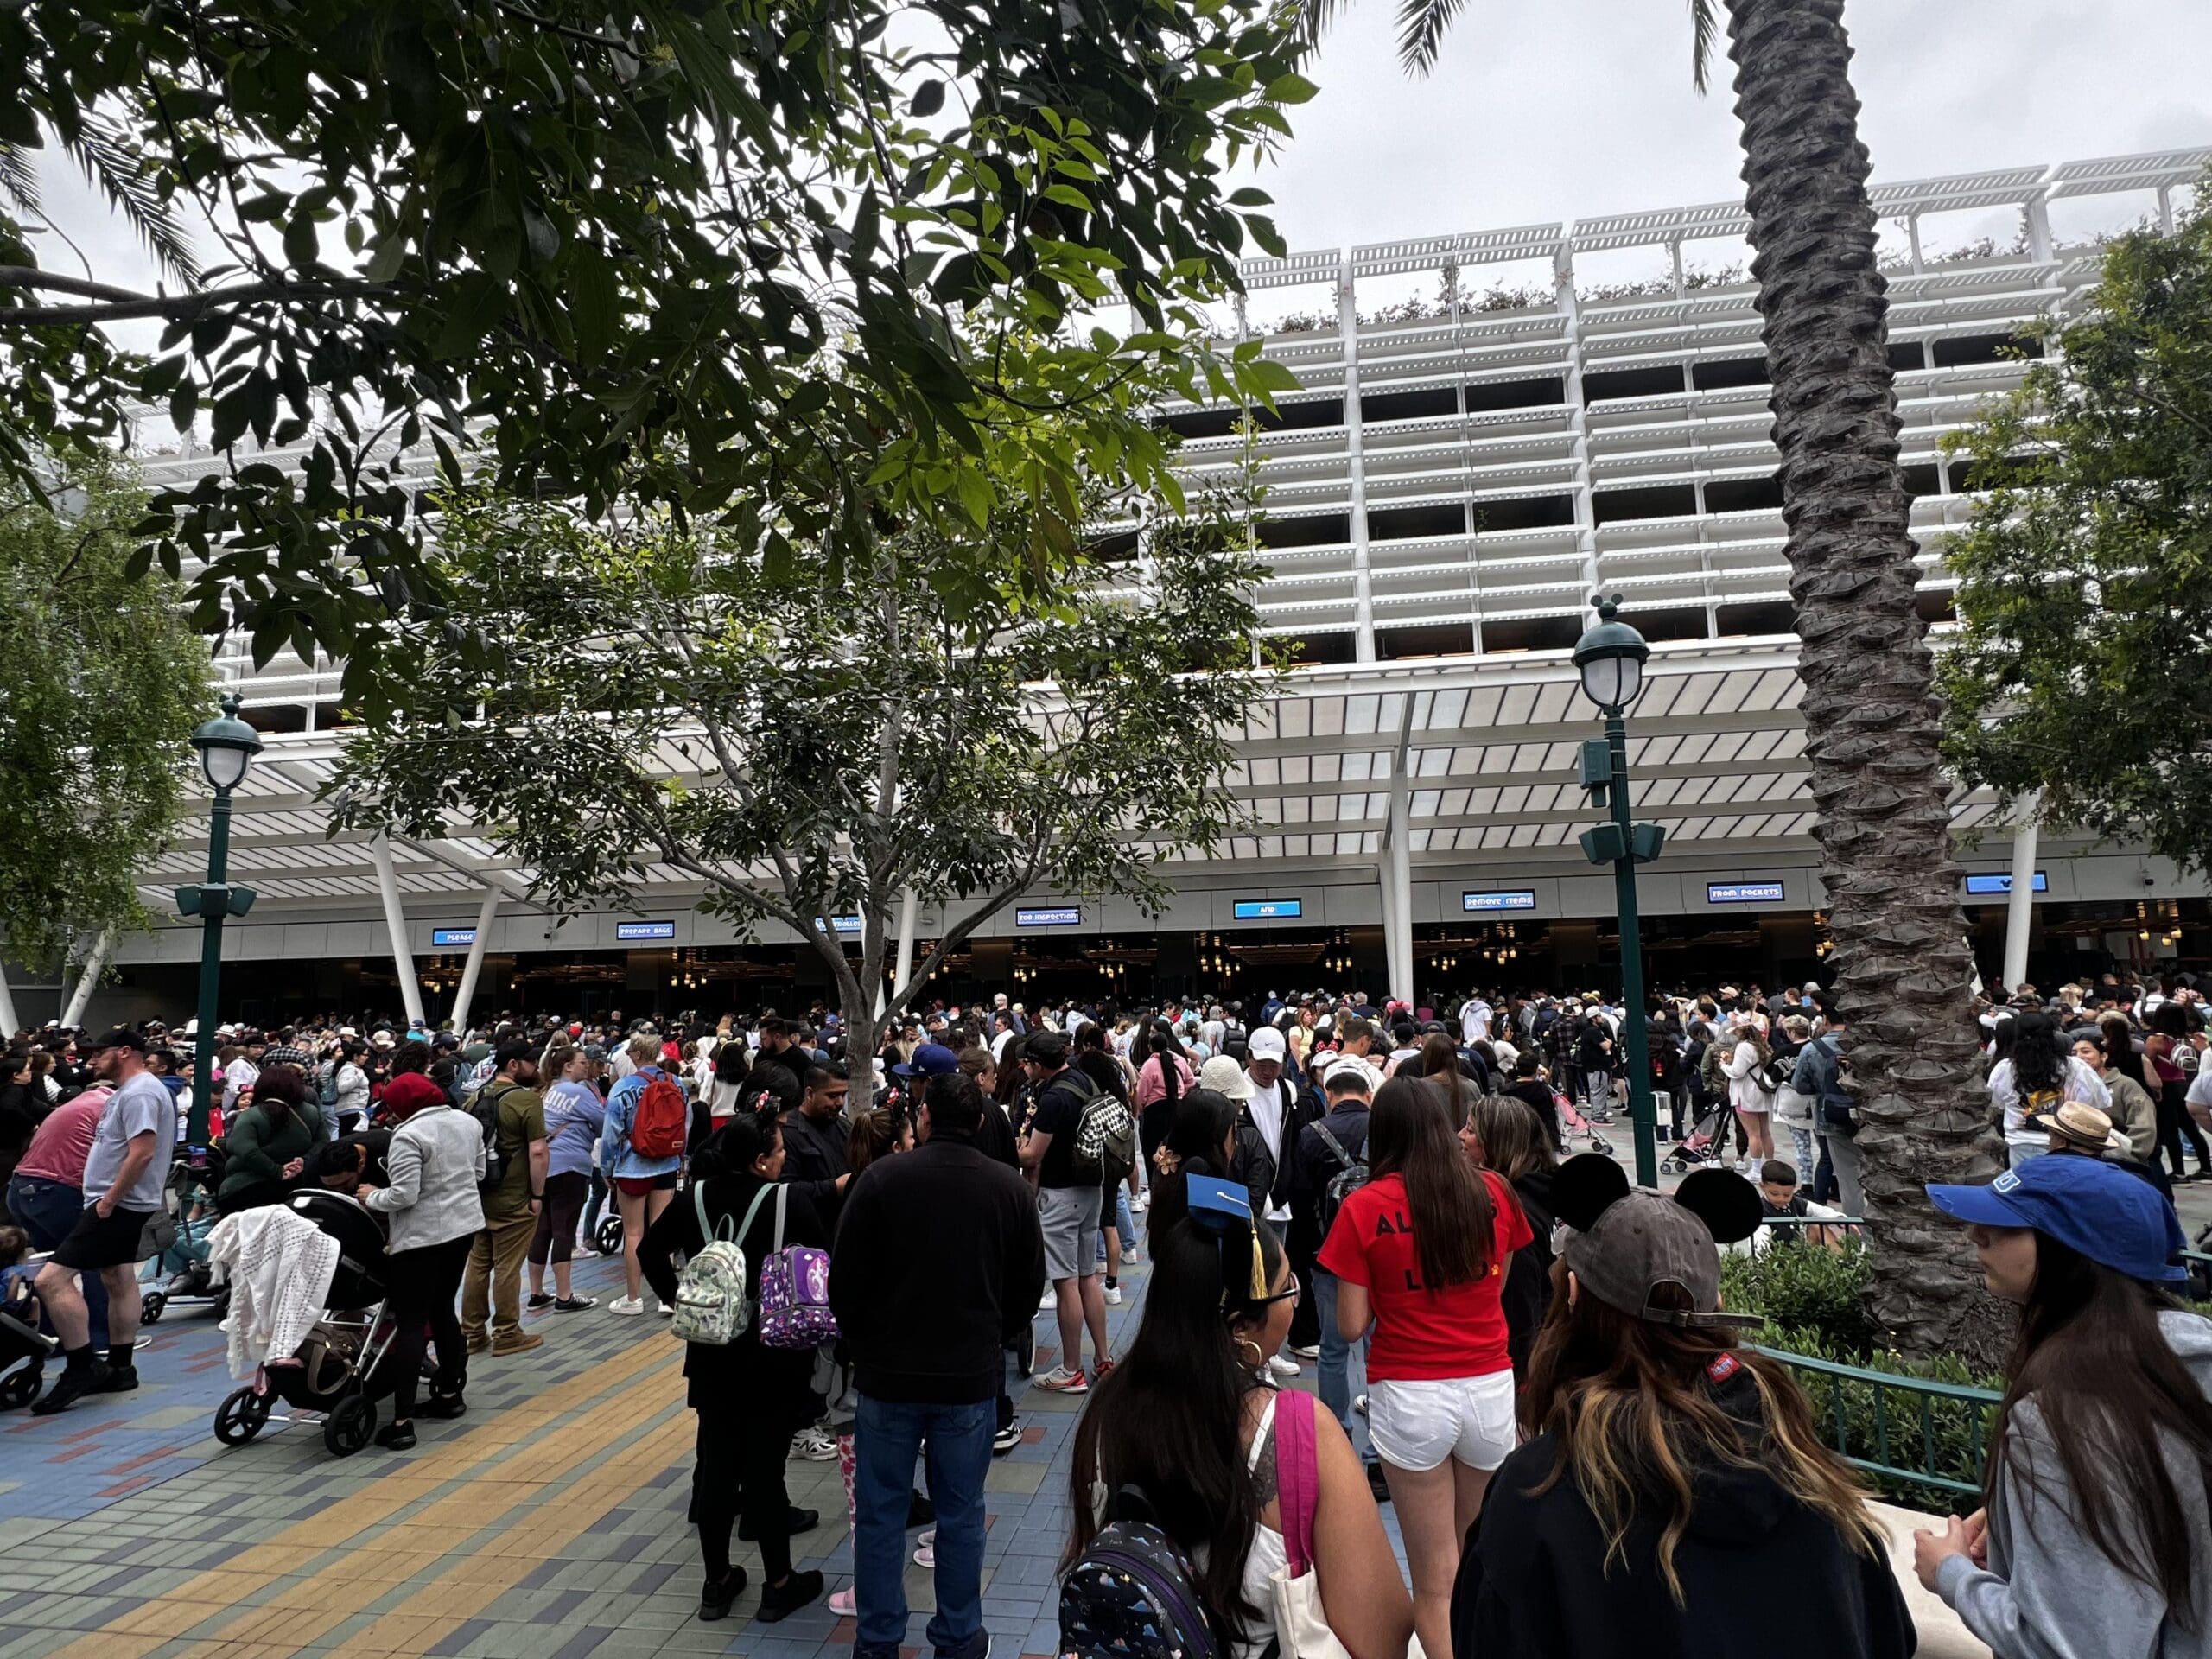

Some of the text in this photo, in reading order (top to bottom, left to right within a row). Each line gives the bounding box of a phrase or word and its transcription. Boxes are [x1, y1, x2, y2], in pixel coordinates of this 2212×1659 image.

[1713, 888, 1780, 898] FROM POCKETS
[1466, 897, 1533, 907] REMOVE ITEMS
[1034, 912, 1077, 921] INSPECTION
